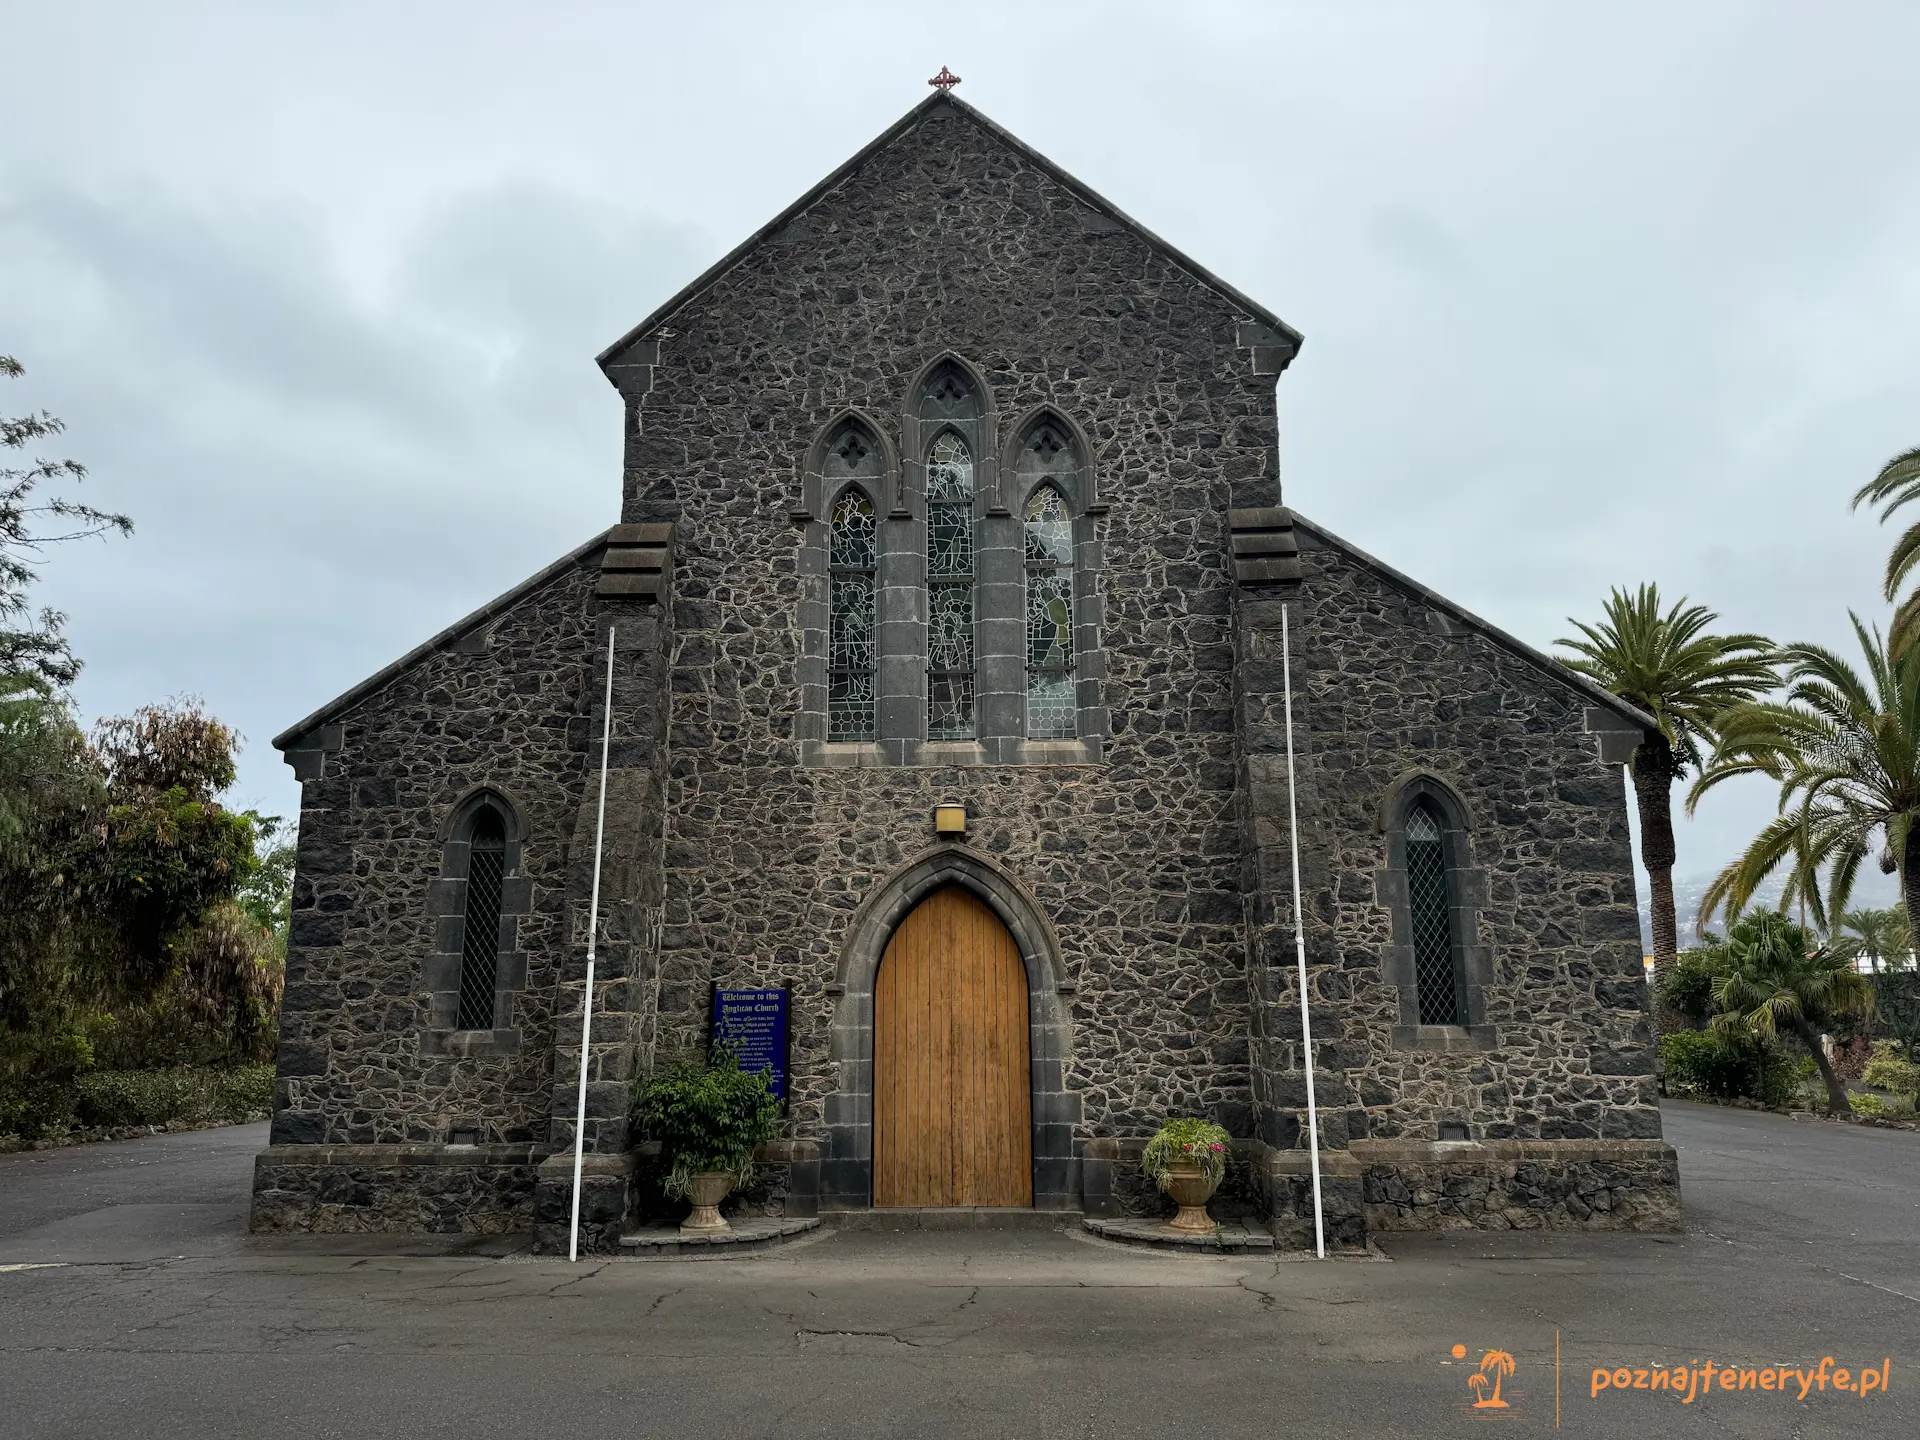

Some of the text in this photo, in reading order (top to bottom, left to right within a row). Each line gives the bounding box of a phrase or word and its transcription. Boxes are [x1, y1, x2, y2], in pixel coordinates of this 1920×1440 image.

[722, 993, 755, 1001] Welcome
[766, 992, 779, 1000] this
[722, 1004, 779, 1013] Anglican Church
